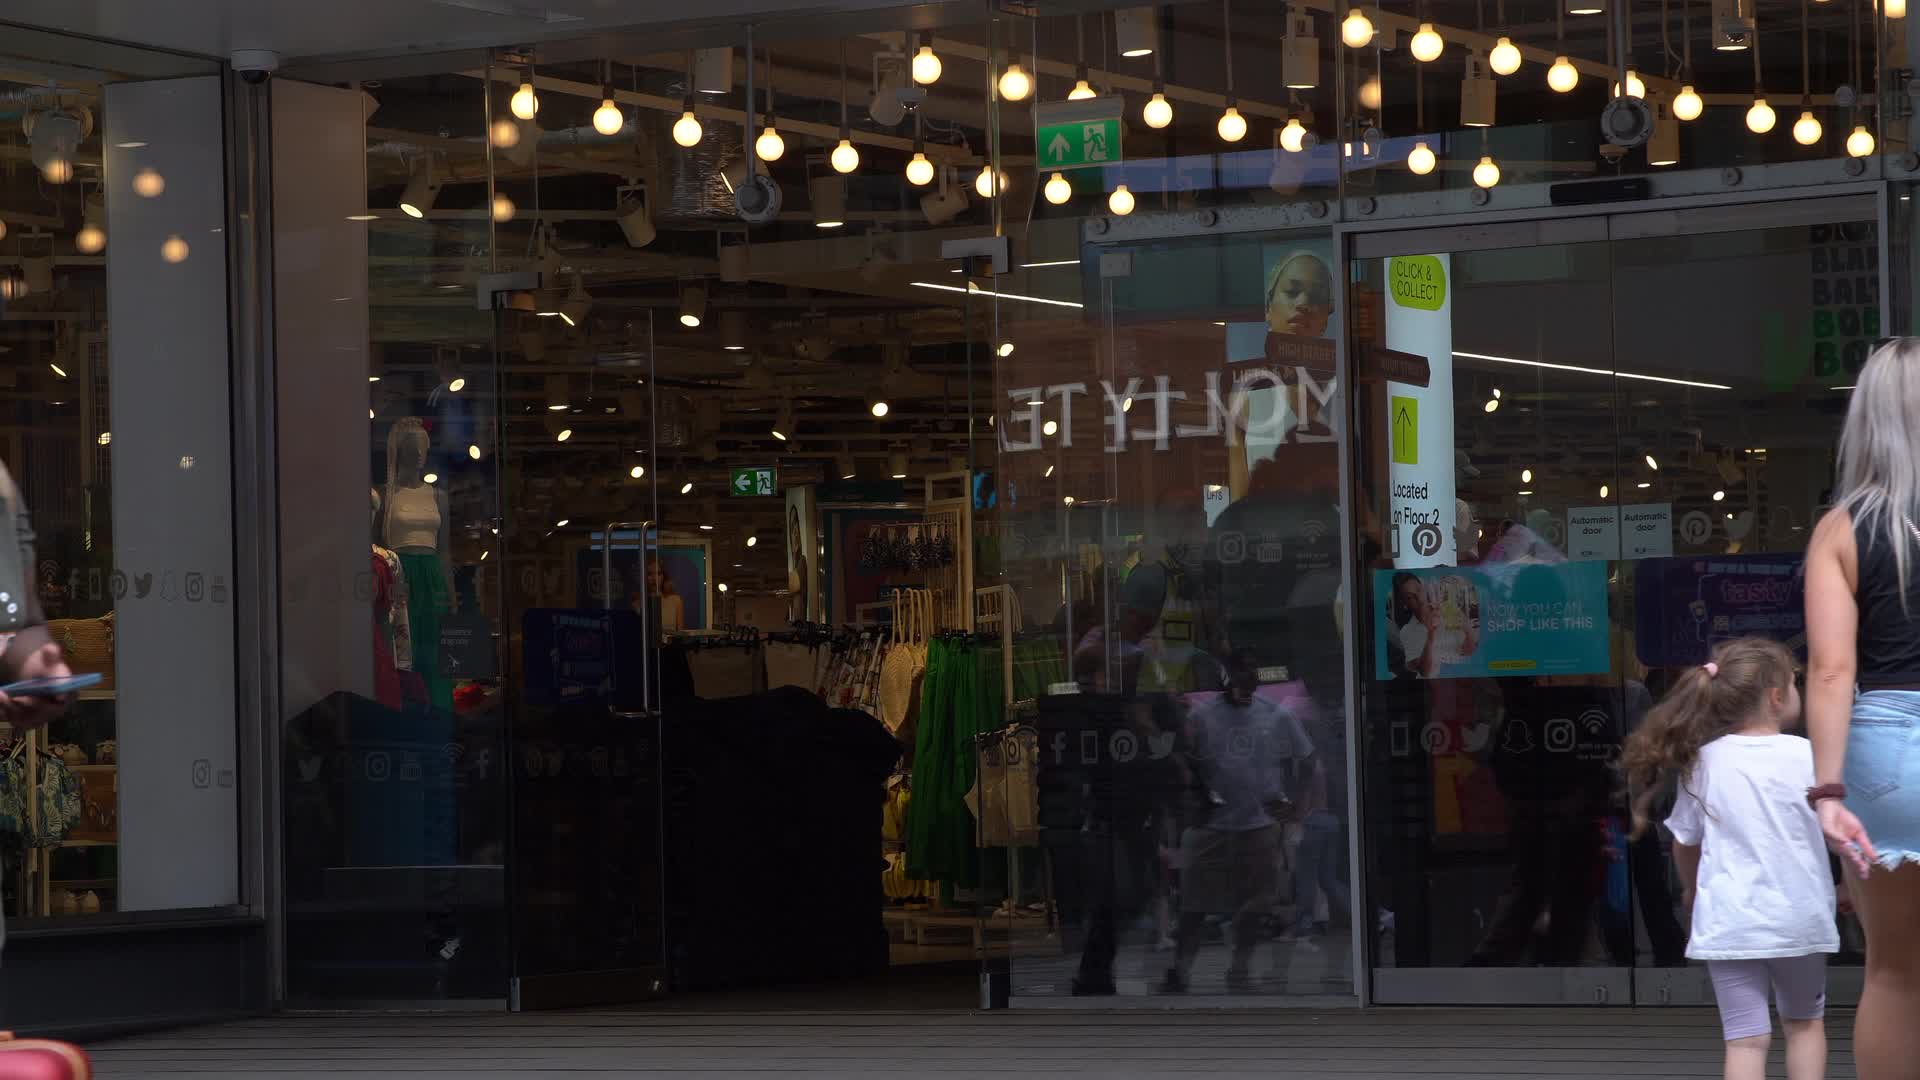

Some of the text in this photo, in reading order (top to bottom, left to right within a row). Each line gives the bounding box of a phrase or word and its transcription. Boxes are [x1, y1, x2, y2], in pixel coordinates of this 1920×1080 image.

[1396, 260, 1432, 281] CLICK &
[1396, 280, 1438, 301] COLLECT
[1393, 480, 1428, 499] Located
[1404, 507, 1429, 525] Floor
[1433, 509, 1440, 526] 2
[1571, 516, 1615, 525] Automatic
[1624, 512, 1668, 521] Automatic
[1582, 527, 1603, 535] door
[1636, 523, 1656, 532] door
[1488, 616, 1593, 632] SHOP LIKE THIS
